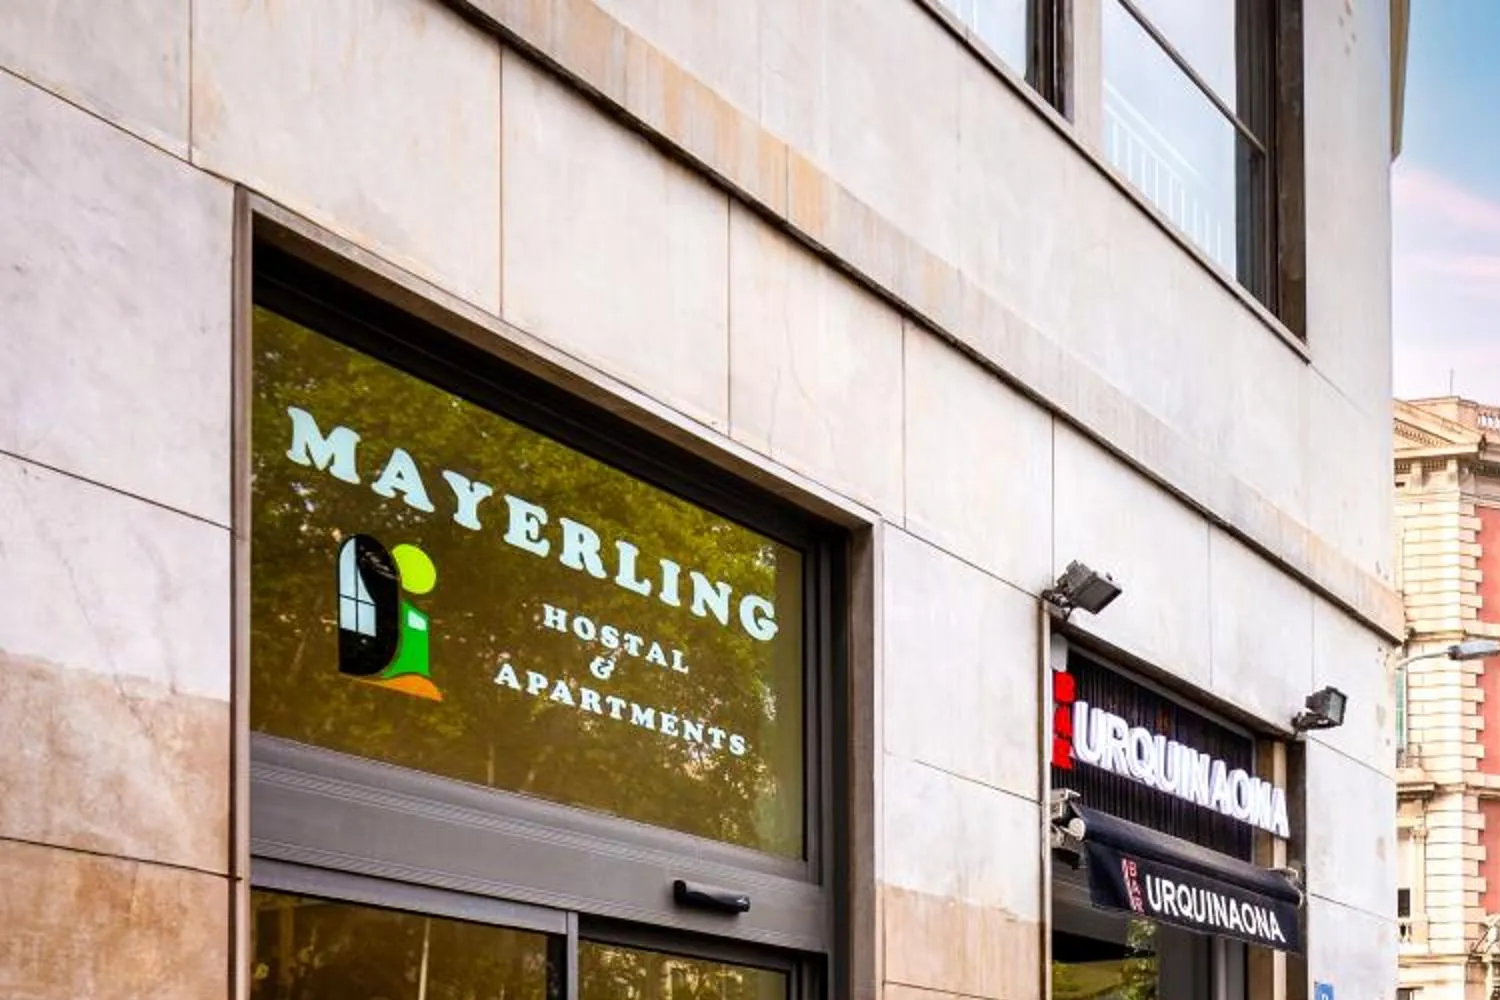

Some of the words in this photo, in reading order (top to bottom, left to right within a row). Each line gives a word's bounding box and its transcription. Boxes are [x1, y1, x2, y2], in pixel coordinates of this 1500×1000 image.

[287, 406, 778, 641] MAYERLING
[543, 603, 690, 674] HOSTAL
[590, 655, 617, 681] &
[494, 663, 748, 756] APARTMENTS
[1073, 701, 1290, 838] URQUINAONA
[1145, 875, 1287, 943] URQUINAONA
